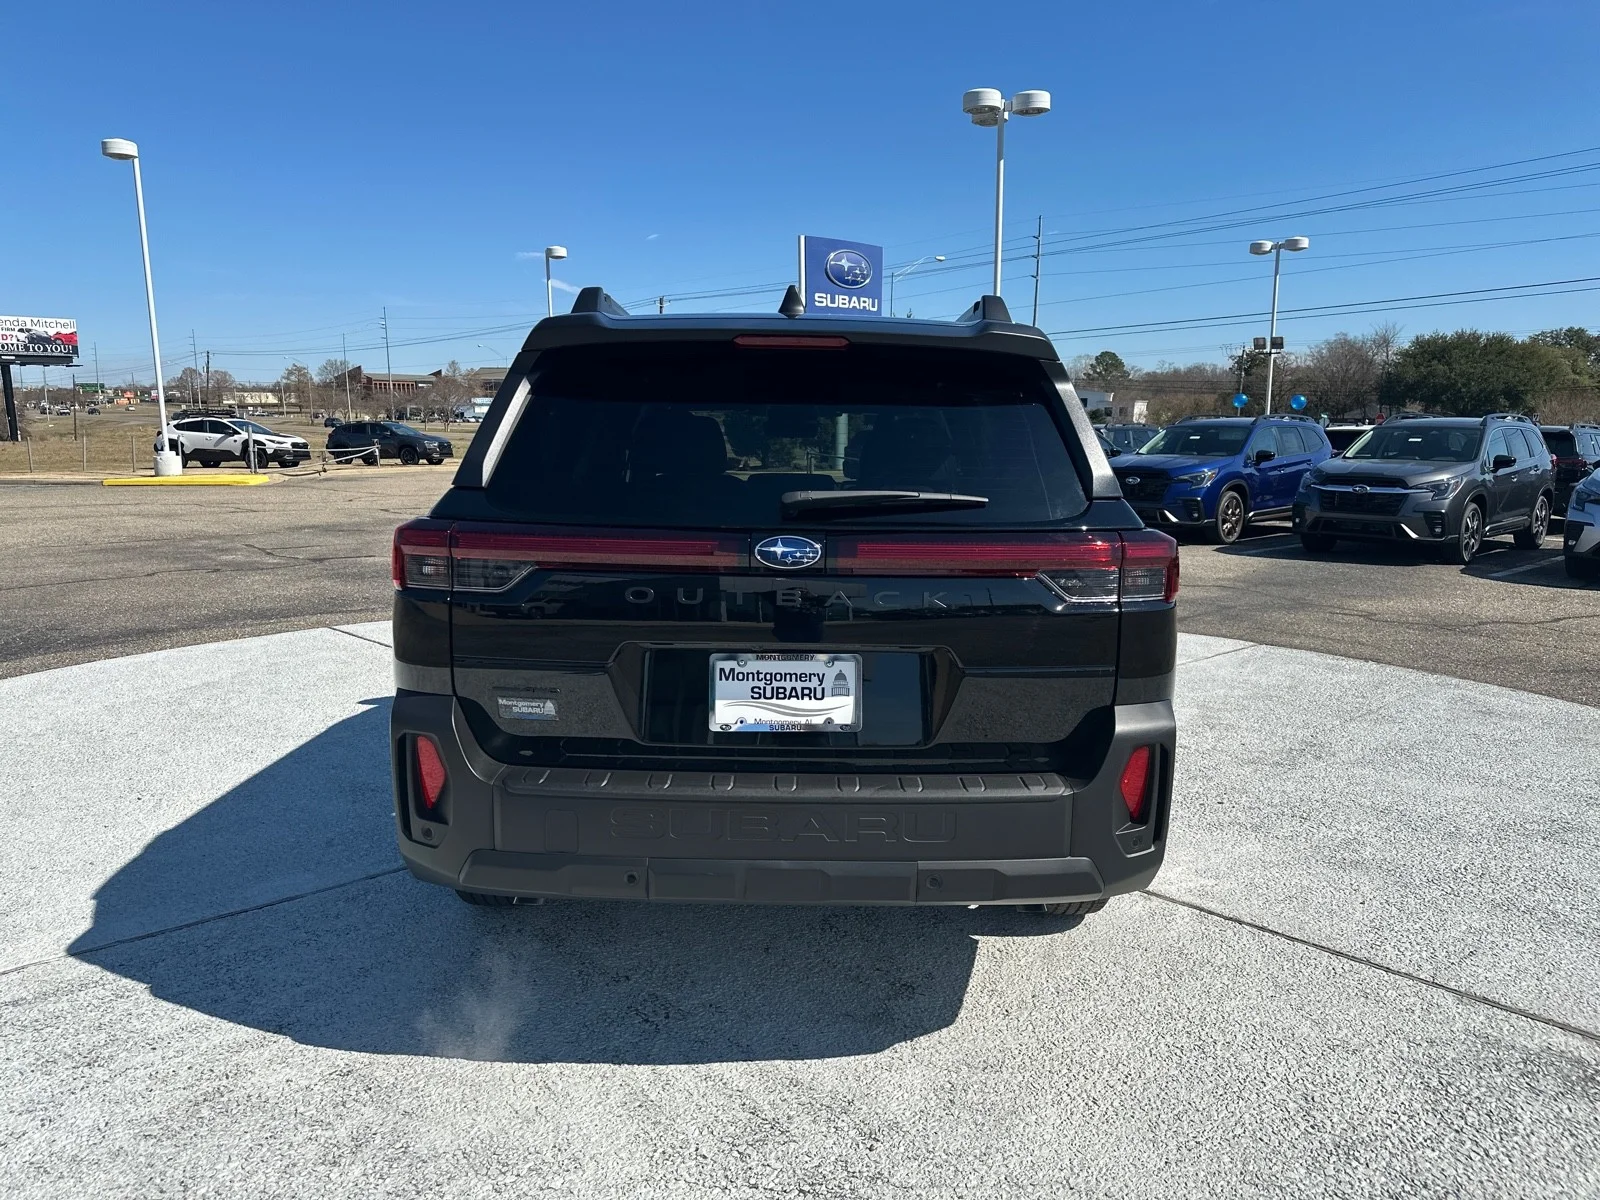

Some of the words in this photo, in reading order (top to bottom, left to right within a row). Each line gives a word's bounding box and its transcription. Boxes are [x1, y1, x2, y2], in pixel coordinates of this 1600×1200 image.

[814, 292, 878, 311] SUBARU
[31, 319, 75, 329] Mitchell
[27, 343, 43, 352] TO
[624, 586, 948, 608] OUTBACK
[719, 667, 825, 686] Montgomery
[750, 686, 825, 700] SUBARU
[498, 699, 544, 708] Montgomery
[512, 706, 544, 714] SUBARU
[609, 807, 958, 843] SUBARU
